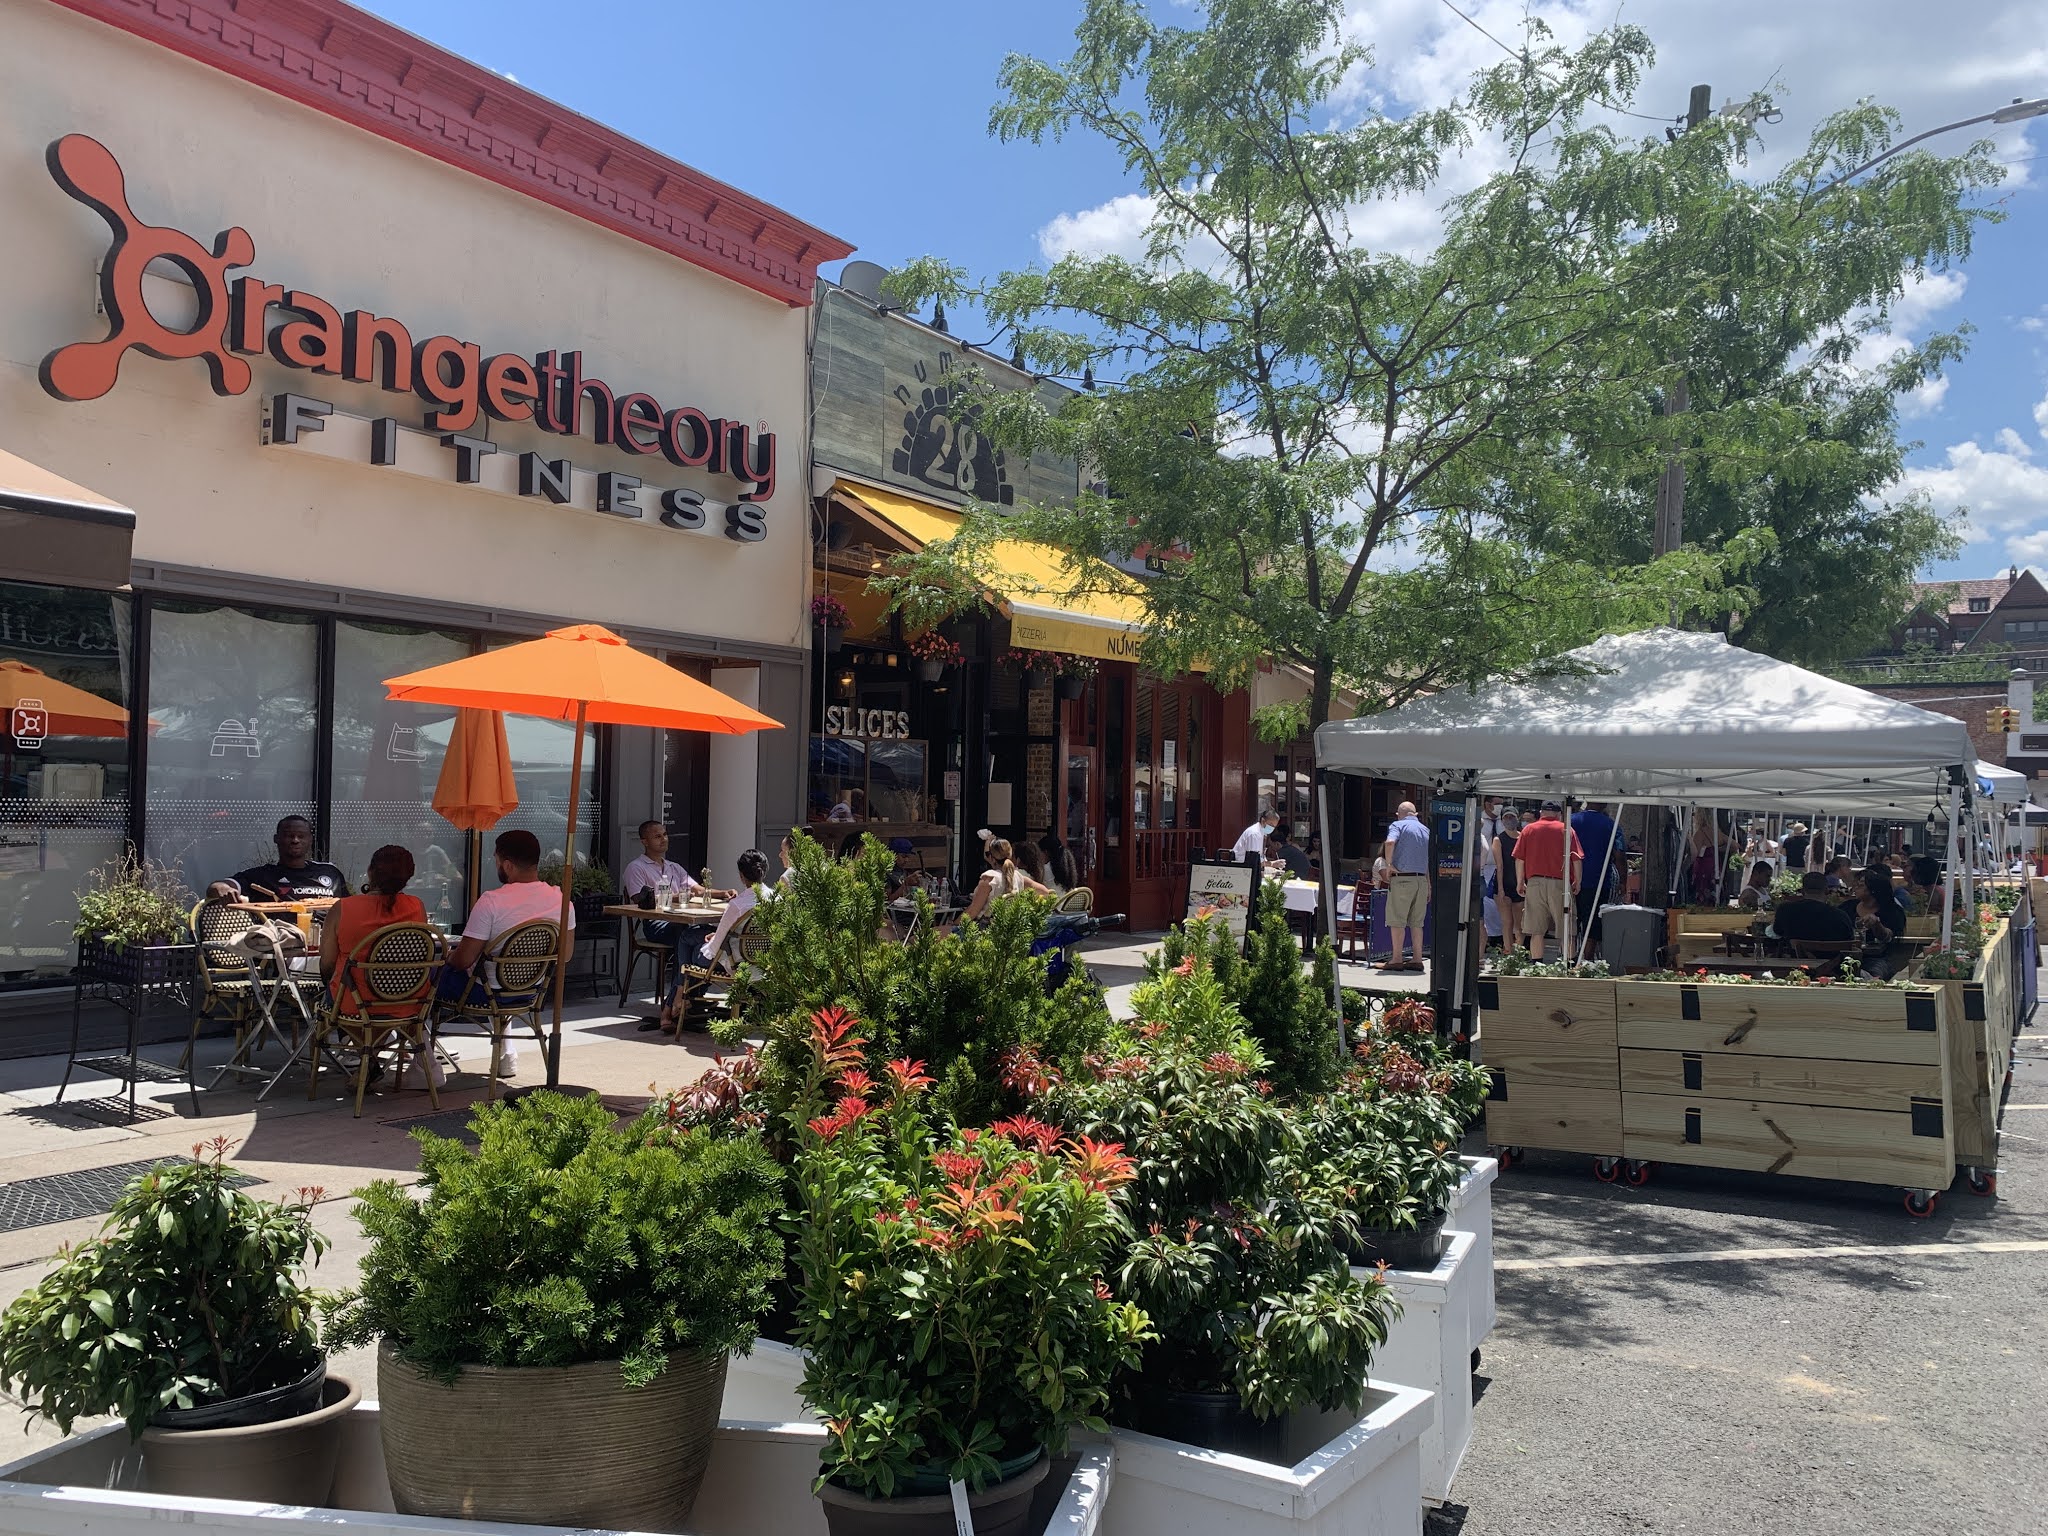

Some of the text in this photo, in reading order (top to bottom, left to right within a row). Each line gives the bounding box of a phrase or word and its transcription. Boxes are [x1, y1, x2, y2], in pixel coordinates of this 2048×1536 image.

[924, 413, 977, 491] 28
[273, 392, 767, 542] FITNESS
[1016, 626, 1047, 641] PIZZERIA
[826, 705, 910, 739] SLICES
[1438, 805, 1464, 813] 400998
[1447, 819, 1462, 840] P
[292, 888, 334, 896] YOKOHAMA
[1204, 879, 1234, 890] Gelato
